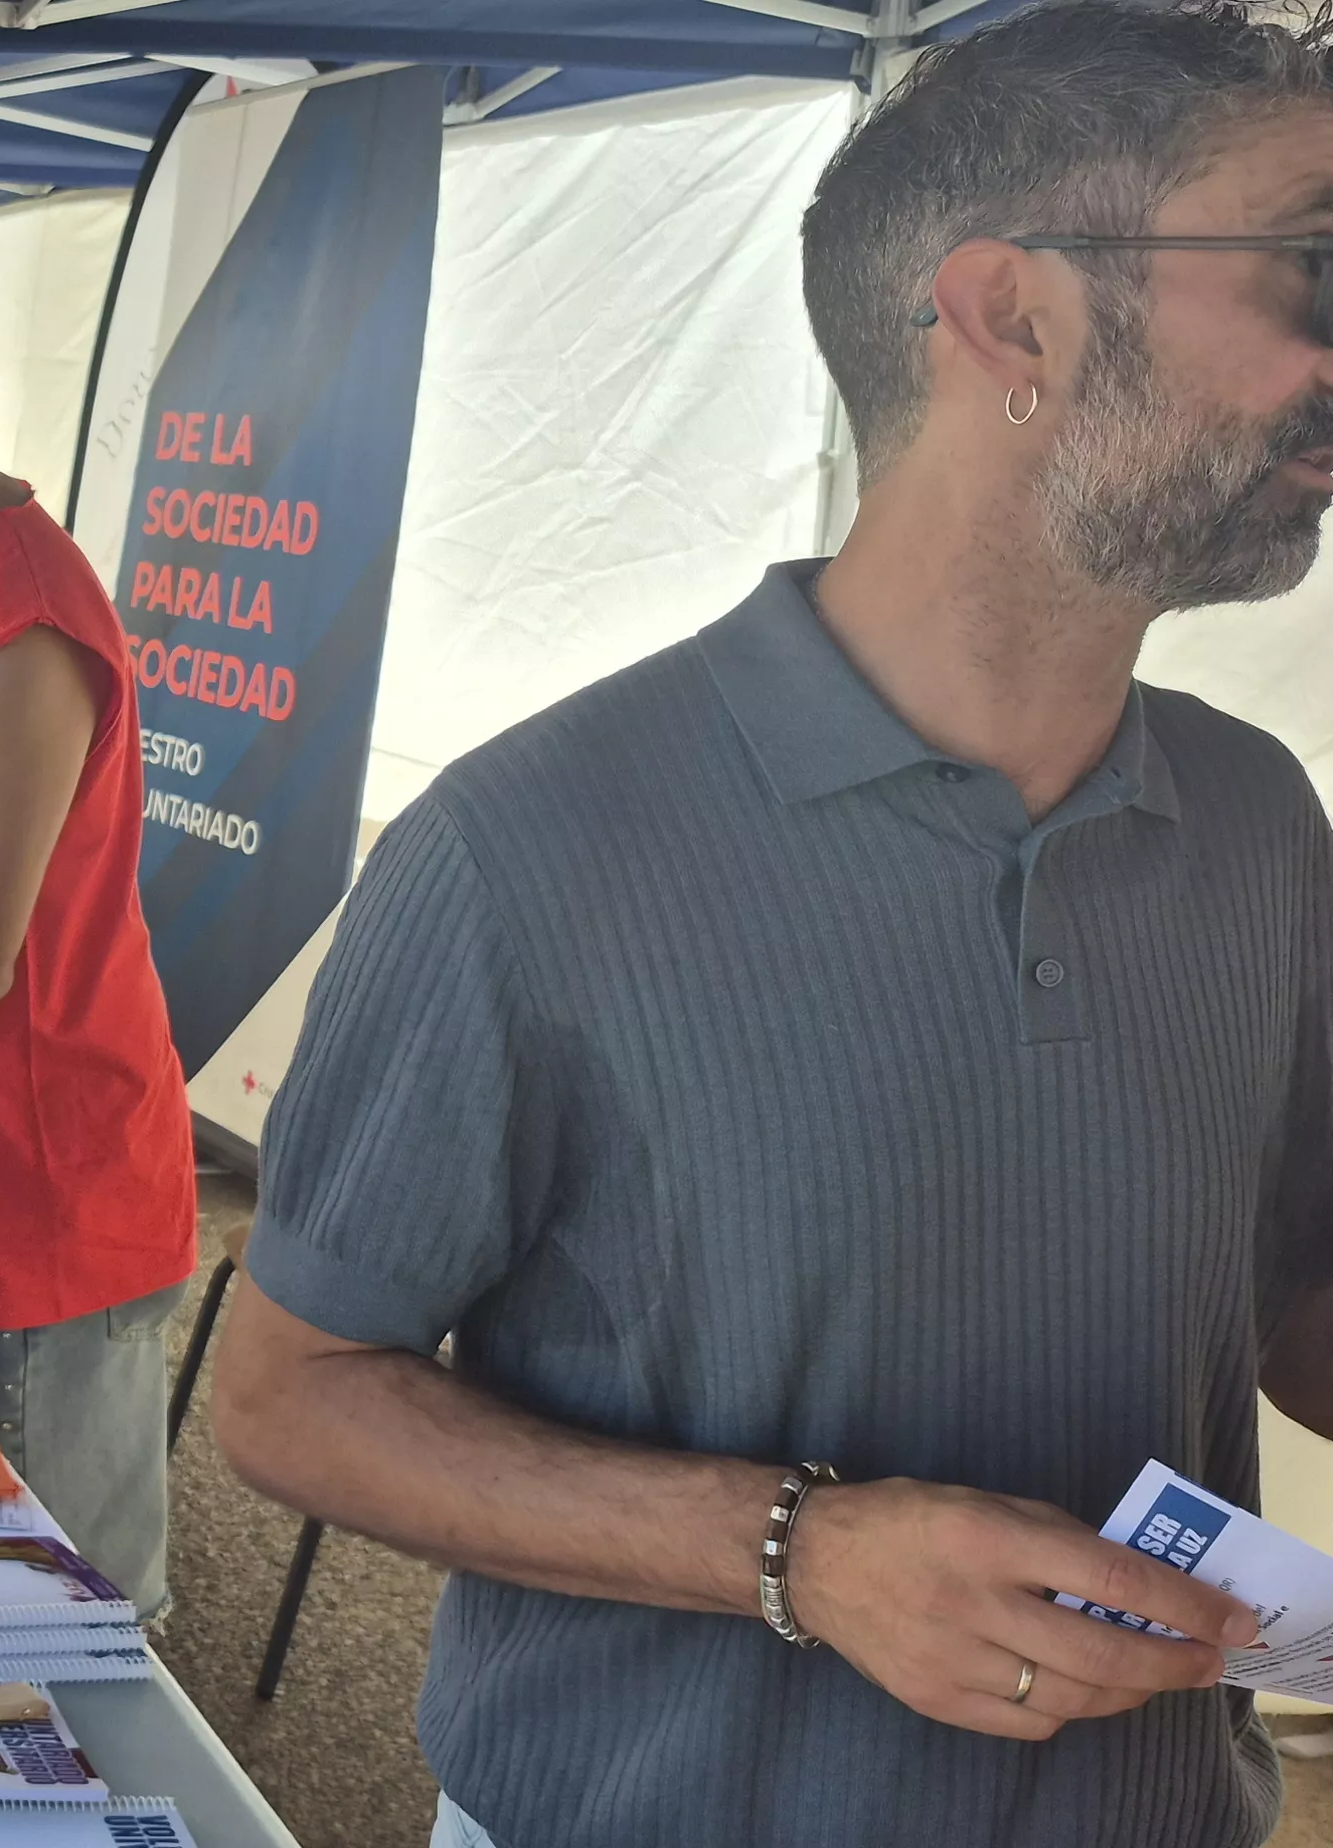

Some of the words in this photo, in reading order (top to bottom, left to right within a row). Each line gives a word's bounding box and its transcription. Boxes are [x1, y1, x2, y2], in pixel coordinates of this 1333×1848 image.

[155, 412, 206, 463] DE
[210, 413, 253, 467] LA
[142, 486, 320, 556] SOCIEDAD
[130, 560, 221, 624] PARA
[227, 576, 273, 634] LA
[125, 634, 297, 721] SOCIEDAD
[139, 728, 205, 776] ESTRO
[1137, 1512, 1183, 1556] SER
[1182, 1527, 1210, 1555] UZ
